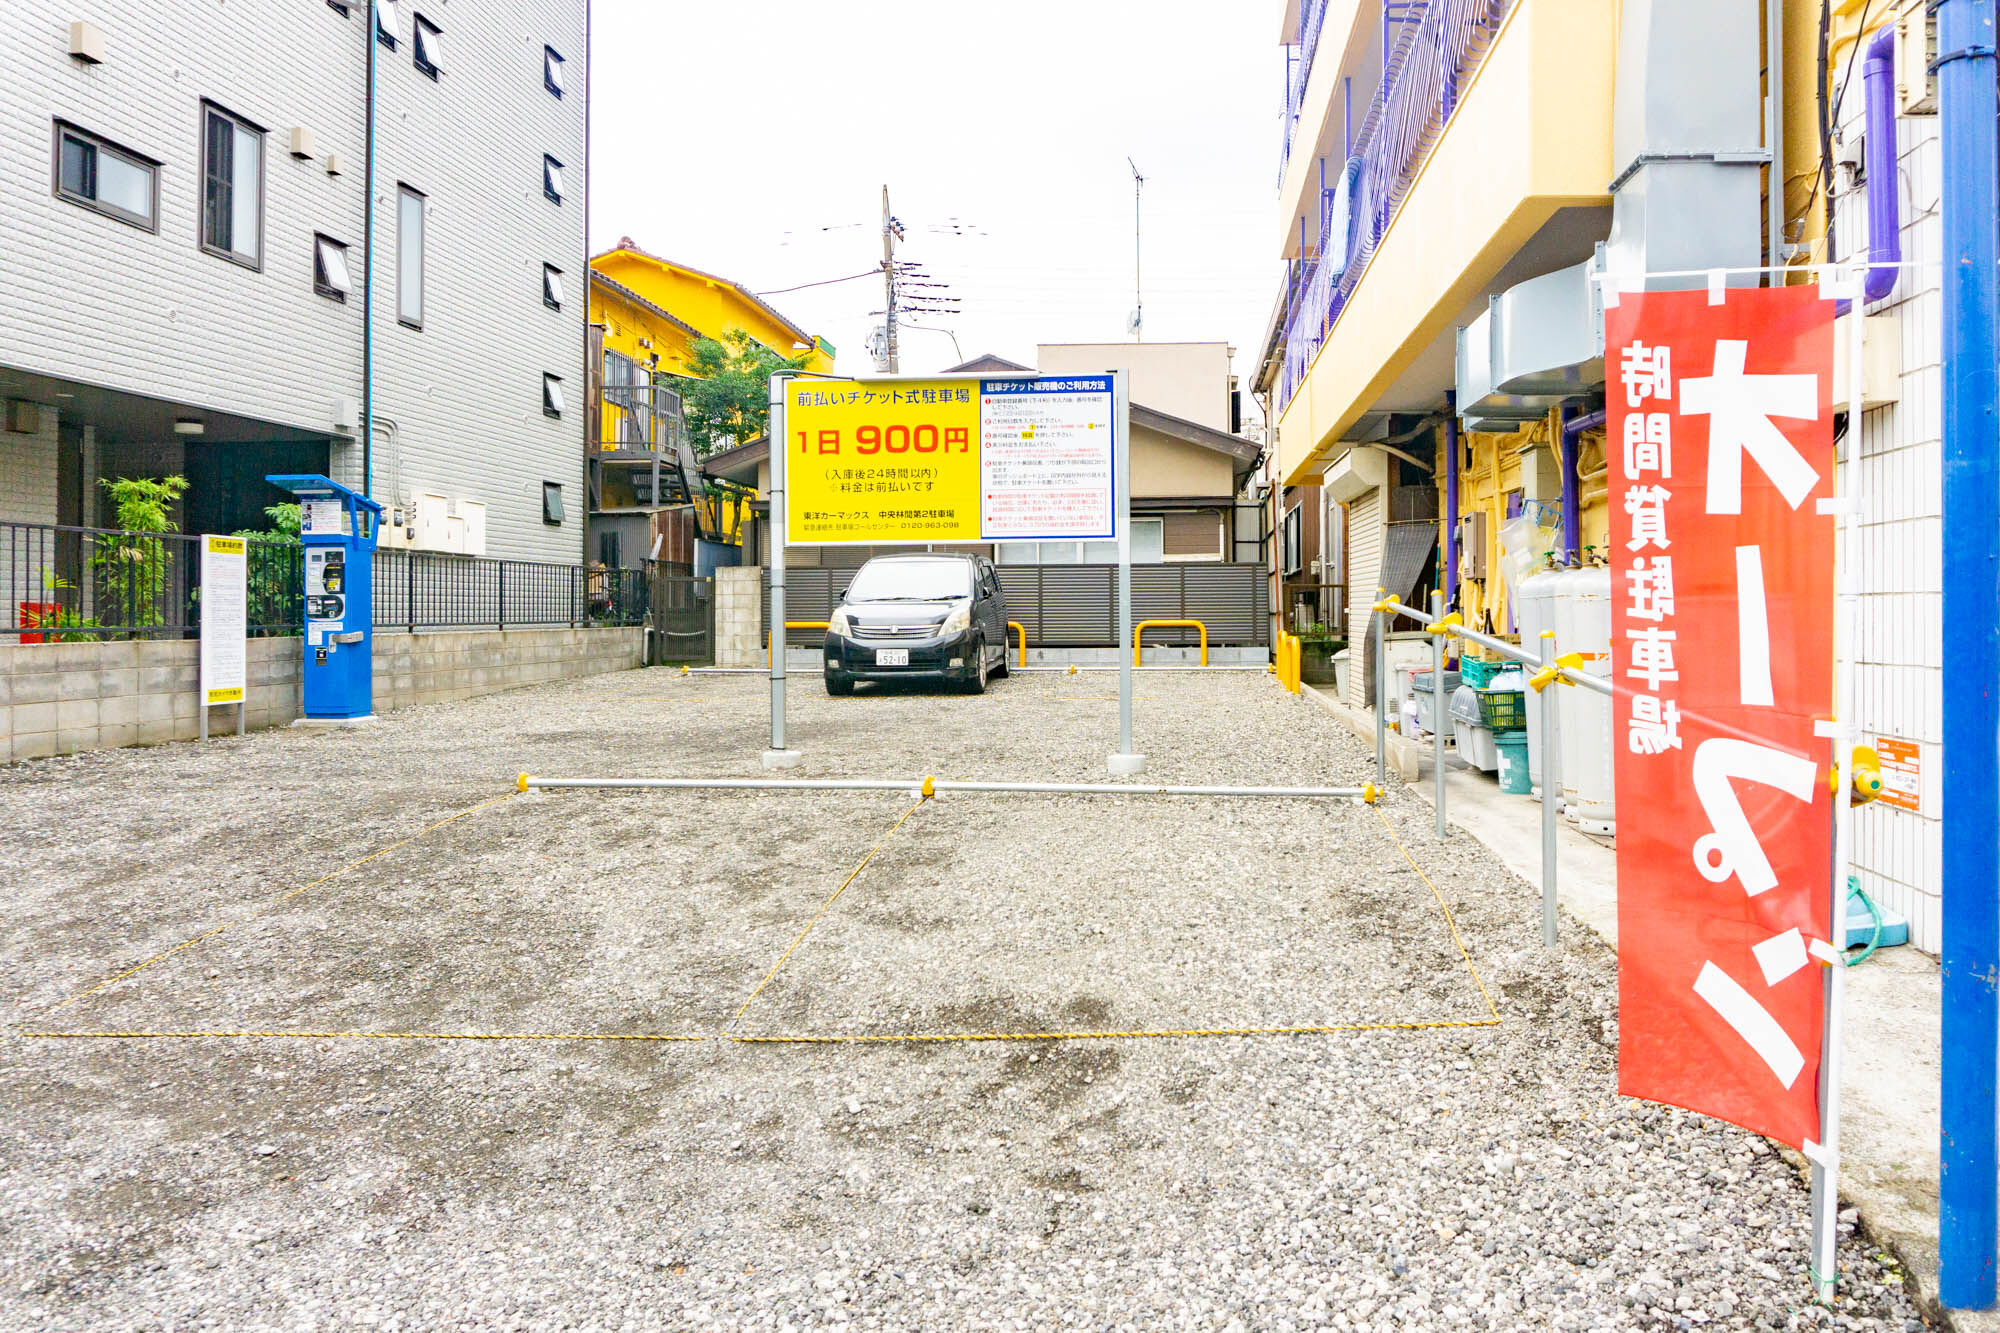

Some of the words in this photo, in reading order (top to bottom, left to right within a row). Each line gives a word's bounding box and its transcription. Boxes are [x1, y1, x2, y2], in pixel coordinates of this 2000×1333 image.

[798, 388, 970, 407] 前払いチケット式駐車場
[797, 430, 840, 455] 1日
[856, 424, 968, 455] 900円
[804, 511, 869, 520] 東洋カーマックス
[878, 510, 955, 519] 中央林間第2駐車場
